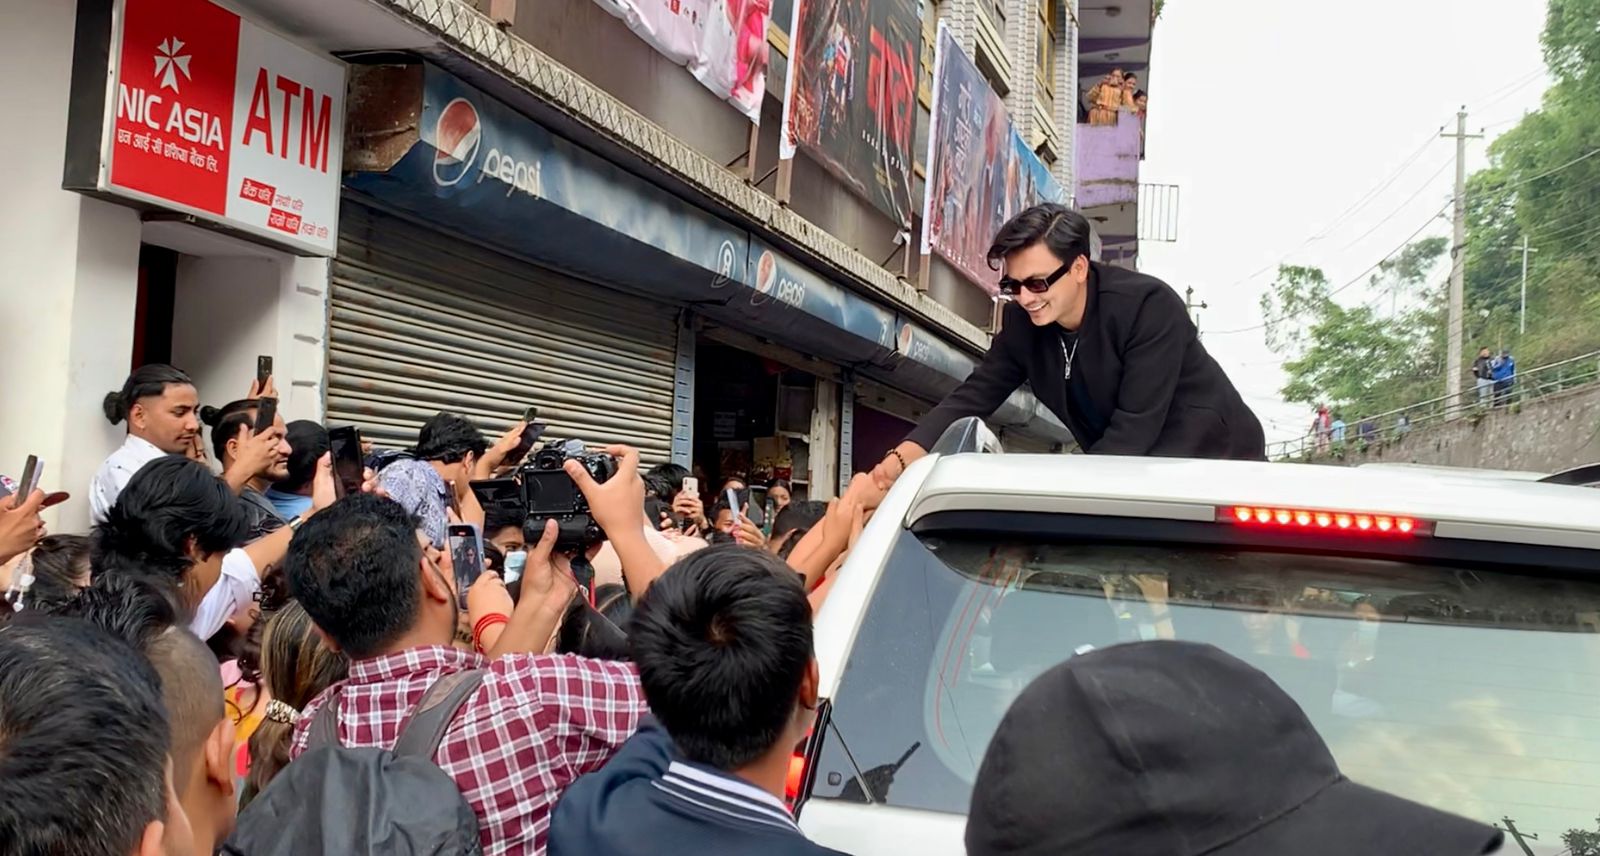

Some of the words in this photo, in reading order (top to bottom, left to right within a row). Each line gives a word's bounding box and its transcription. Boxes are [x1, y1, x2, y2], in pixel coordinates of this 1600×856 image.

[118, 83, 162, 131] NIC
[165, 102, 224, 151] ASIA
[242, 67, 332, 173] ATM
[477, 148, 541, 200] pepsi
[772, 277, 806, 309] pepsi
